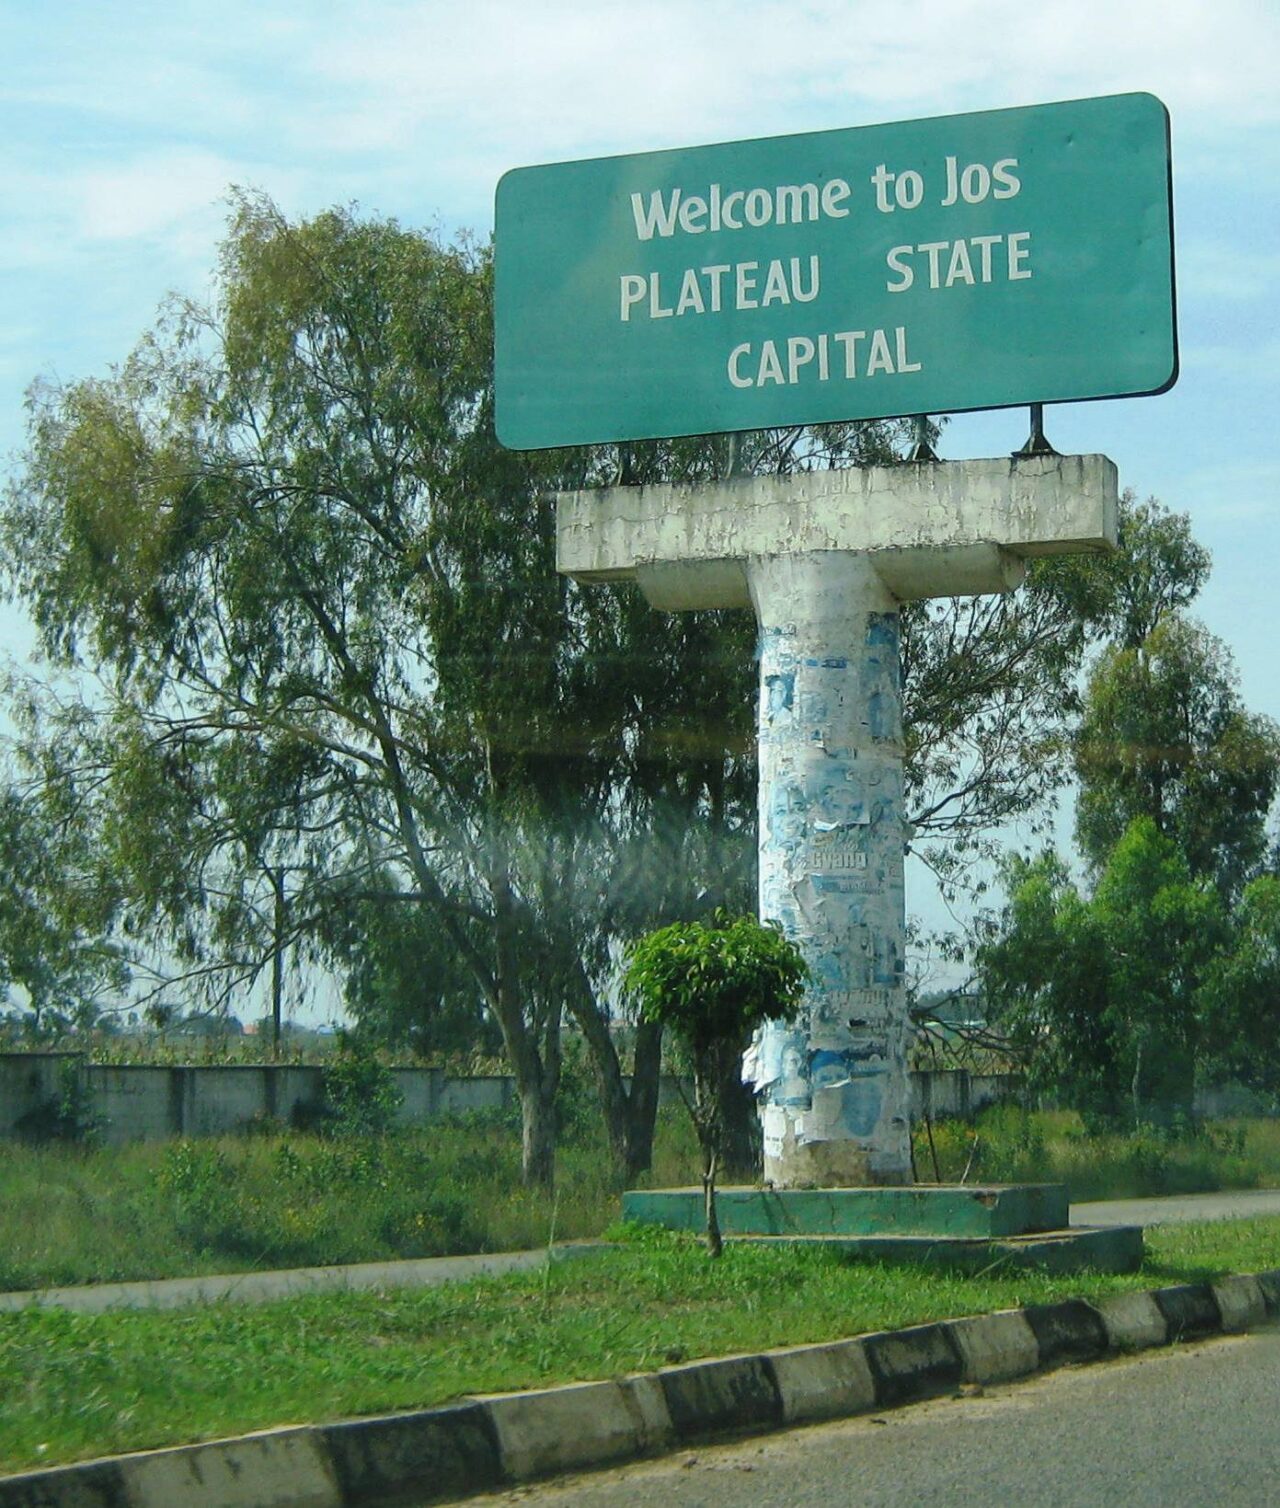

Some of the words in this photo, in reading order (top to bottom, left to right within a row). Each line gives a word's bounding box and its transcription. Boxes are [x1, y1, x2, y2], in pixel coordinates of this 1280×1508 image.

[631, 178, 850, 240] Welcome
[871, 164, 923, 213] to
[942, 156, 1020, 206] Jos
[620, 255, 819, 321] PLATEAU
[887, 232, 1031, 292] STATE
[728, 326, 921, 388] CAPITAL
